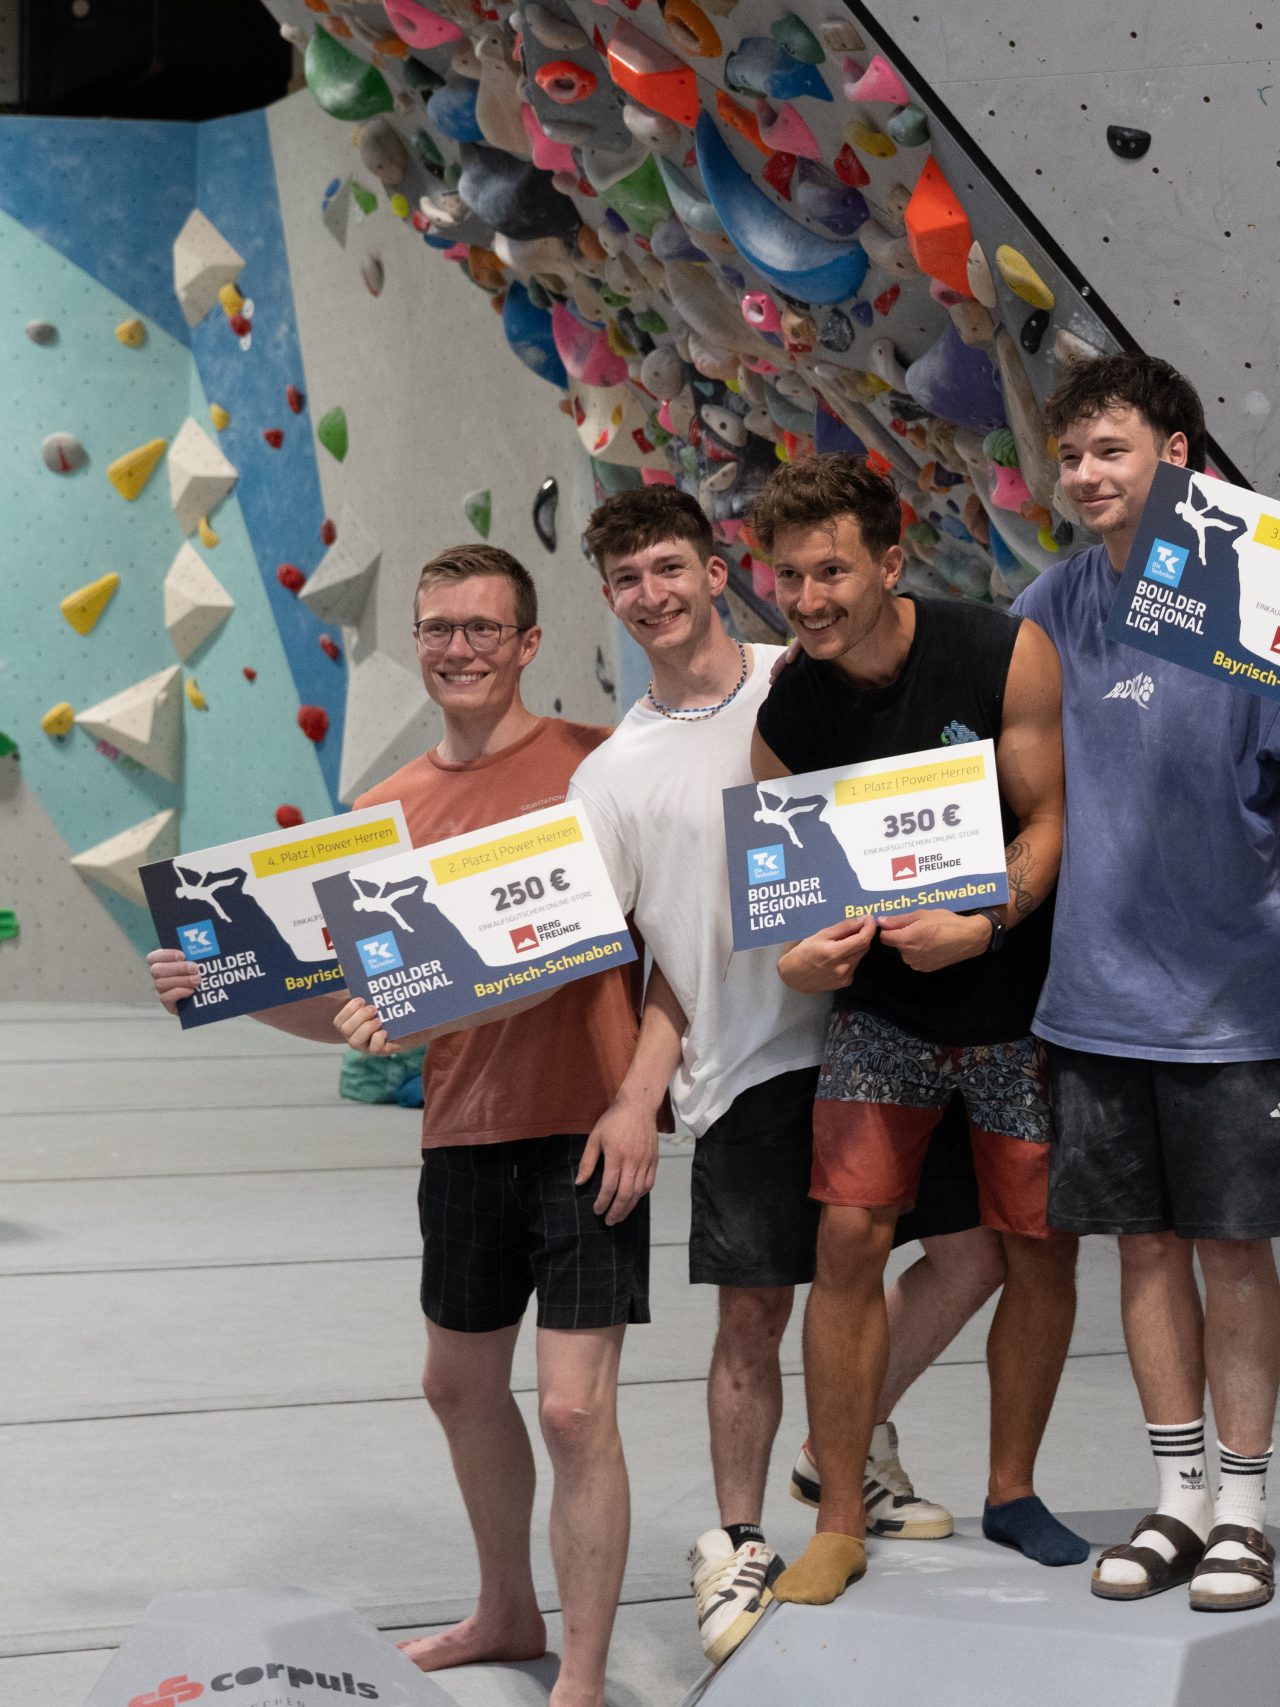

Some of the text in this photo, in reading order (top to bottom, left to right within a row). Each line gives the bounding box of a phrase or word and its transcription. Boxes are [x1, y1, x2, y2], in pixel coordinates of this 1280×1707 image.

[1271, 528, 1280, 541] 3.
[1136, 580, 1206, 618] BOULDER
[1126, 611, 1158, 635] LIGA
[1131, 596, 1204, 635] REGIONAL
[851, 786, 861, 795] 1.
[864, 779, 892, 793] Platz
[902, 772, 937, 787] Power
[941, 764, 980, 779] Herren
[883, 804, 962, 838] 350 €
[268, 856, 279, 866] 4.
[281, 849, 309, 863] Platz
[317, 838, 351, 854] Power
[354, 827, 394, 845] Herren
[448, 863, 460, 873] 2.
[463, 852, 491, 869] Platz
[499, 839, 534, 857] Power
[537, 826, 576, 845] Herren
[864, 829, 980, 856] EINKAUFSGUTSCHEIN ONLINE-STORE
[918, 853, 943, 865] BERG
[919, 858, 961, 873] FREUNDE
[490, 867, 571, 912] 250 €
[748, 877, 820, 901] BOULDER
[750, 891, 827, 916] REGIONAL
[845, 881, 997, 919] Bayrisch-Schwaben
[479, 890, 592, 932] EINKAUFSGUTSCHEIN ONLINE-STORE
[751, 913, 785, 931] LIGA
[536, 919, 561, 934] BERG
[539, 922, 581, 942] FREUNDE
[198, 951, 257, 976] OULDER
[367, 960, 443, 994] BOULDER
[474, 941, 623, 998] Bayrisch-Schwaben
[193, 989, 229, 1008] LIGA
[372, 974, 453, 1008] REGIONAL
[378, 1001, 416, 1023] LIGA
[210, 1663, 379, 1699] corpuls
